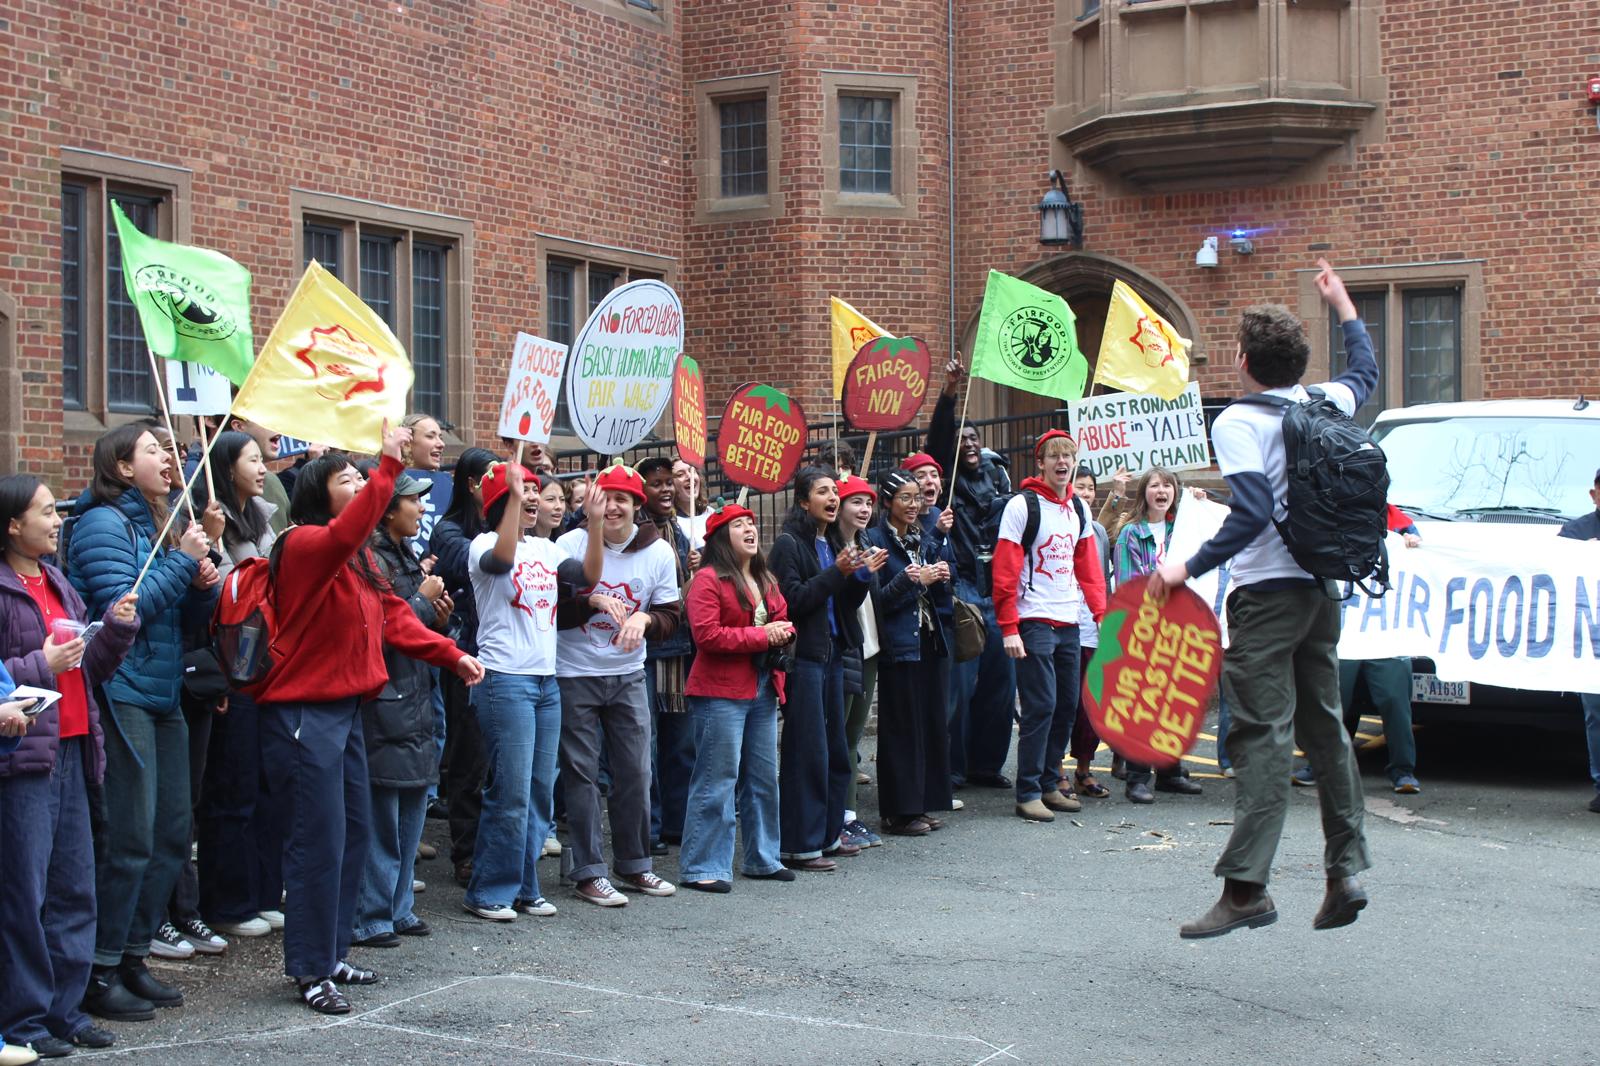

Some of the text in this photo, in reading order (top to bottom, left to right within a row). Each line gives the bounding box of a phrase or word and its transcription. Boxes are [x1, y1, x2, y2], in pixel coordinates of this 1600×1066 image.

[621, 303, 659, 335] FORCED
[655, 303, 681, 337] LABOR
[1010, 309, 1067, 338] FAIRFOOD
[518, 341, 564, 378] CHOOSE
[582, 344, 618, 379] BASIC
[614, 346, 651, 378] HUMAN
[531, 378, 555, 436] FOOD
[588, 380, 661, 413] FAIR WAGES
[680, 373, 699, 408] YALE
[867, 388, 905, 416] NOW
[592, 413, 647, 446] Y NOT?
[678, 397, 704, 434] CHOOSE
[730, 400, 801, 446] FAIR FOOD
[675, 421, 706, 458] FAIR FOOD
[737, 425, 786, 461] TASTES
[1077, 420, 1132, 452] ABUSE
[1130, 420, 1144, 433] in
[725, 443, 783, 483] BETTER
[1149, 442, 1206, 468] CHAIN
[1340, 571, 1431, 639] FAIR
[1438, 573, 1557, 660] FOOD
[1133, 615, 1184, 726] TASTES
[1429, 680, 1464, 697] A1638
[1103, 664, 1144, 736] FAIR
[1148, 621, 1219, 759] BETTER
